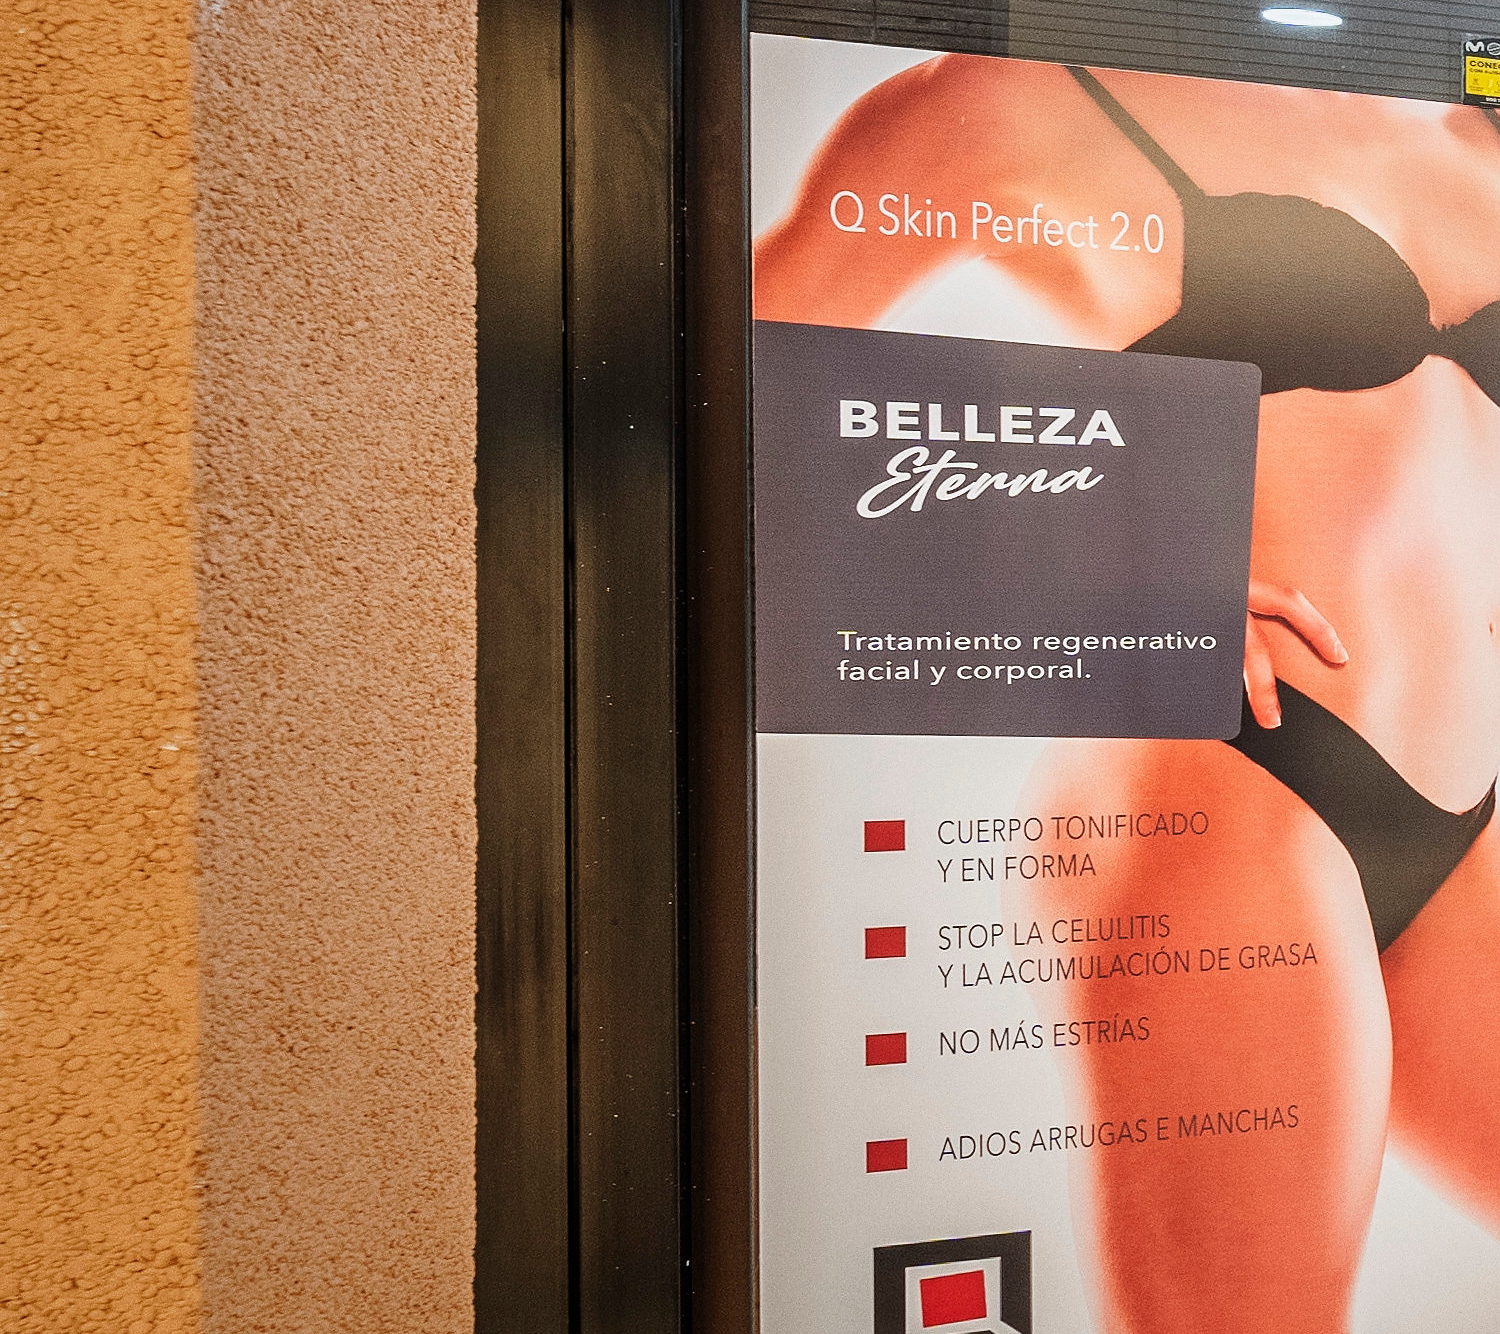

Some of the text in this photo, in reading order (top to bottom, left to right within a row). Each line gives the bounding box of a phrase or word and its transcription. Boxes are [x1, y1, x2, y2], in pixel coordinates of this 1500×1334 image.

[830, 191, 1163, 253] Q Skin Perfect 2.0
[840, 400, 1125, 446] BELLEZA
[856, 446, 1105, 519] Eterna
[837, 631, 1216, 655] Tratamiento regenerativo
[837, 658, 1091, 685] facial y corporal.
[938, 812, 1208, 845] CUERPO TONIFICADO
[939, 914, 1170, 950] STOP LA CELULITIS
[940, 1014, 1149, 1056] NO MÁS ESTRÍAS
[939, 1105, 1299, 1161] ADIOS ARRUGAS E MANCHAS
